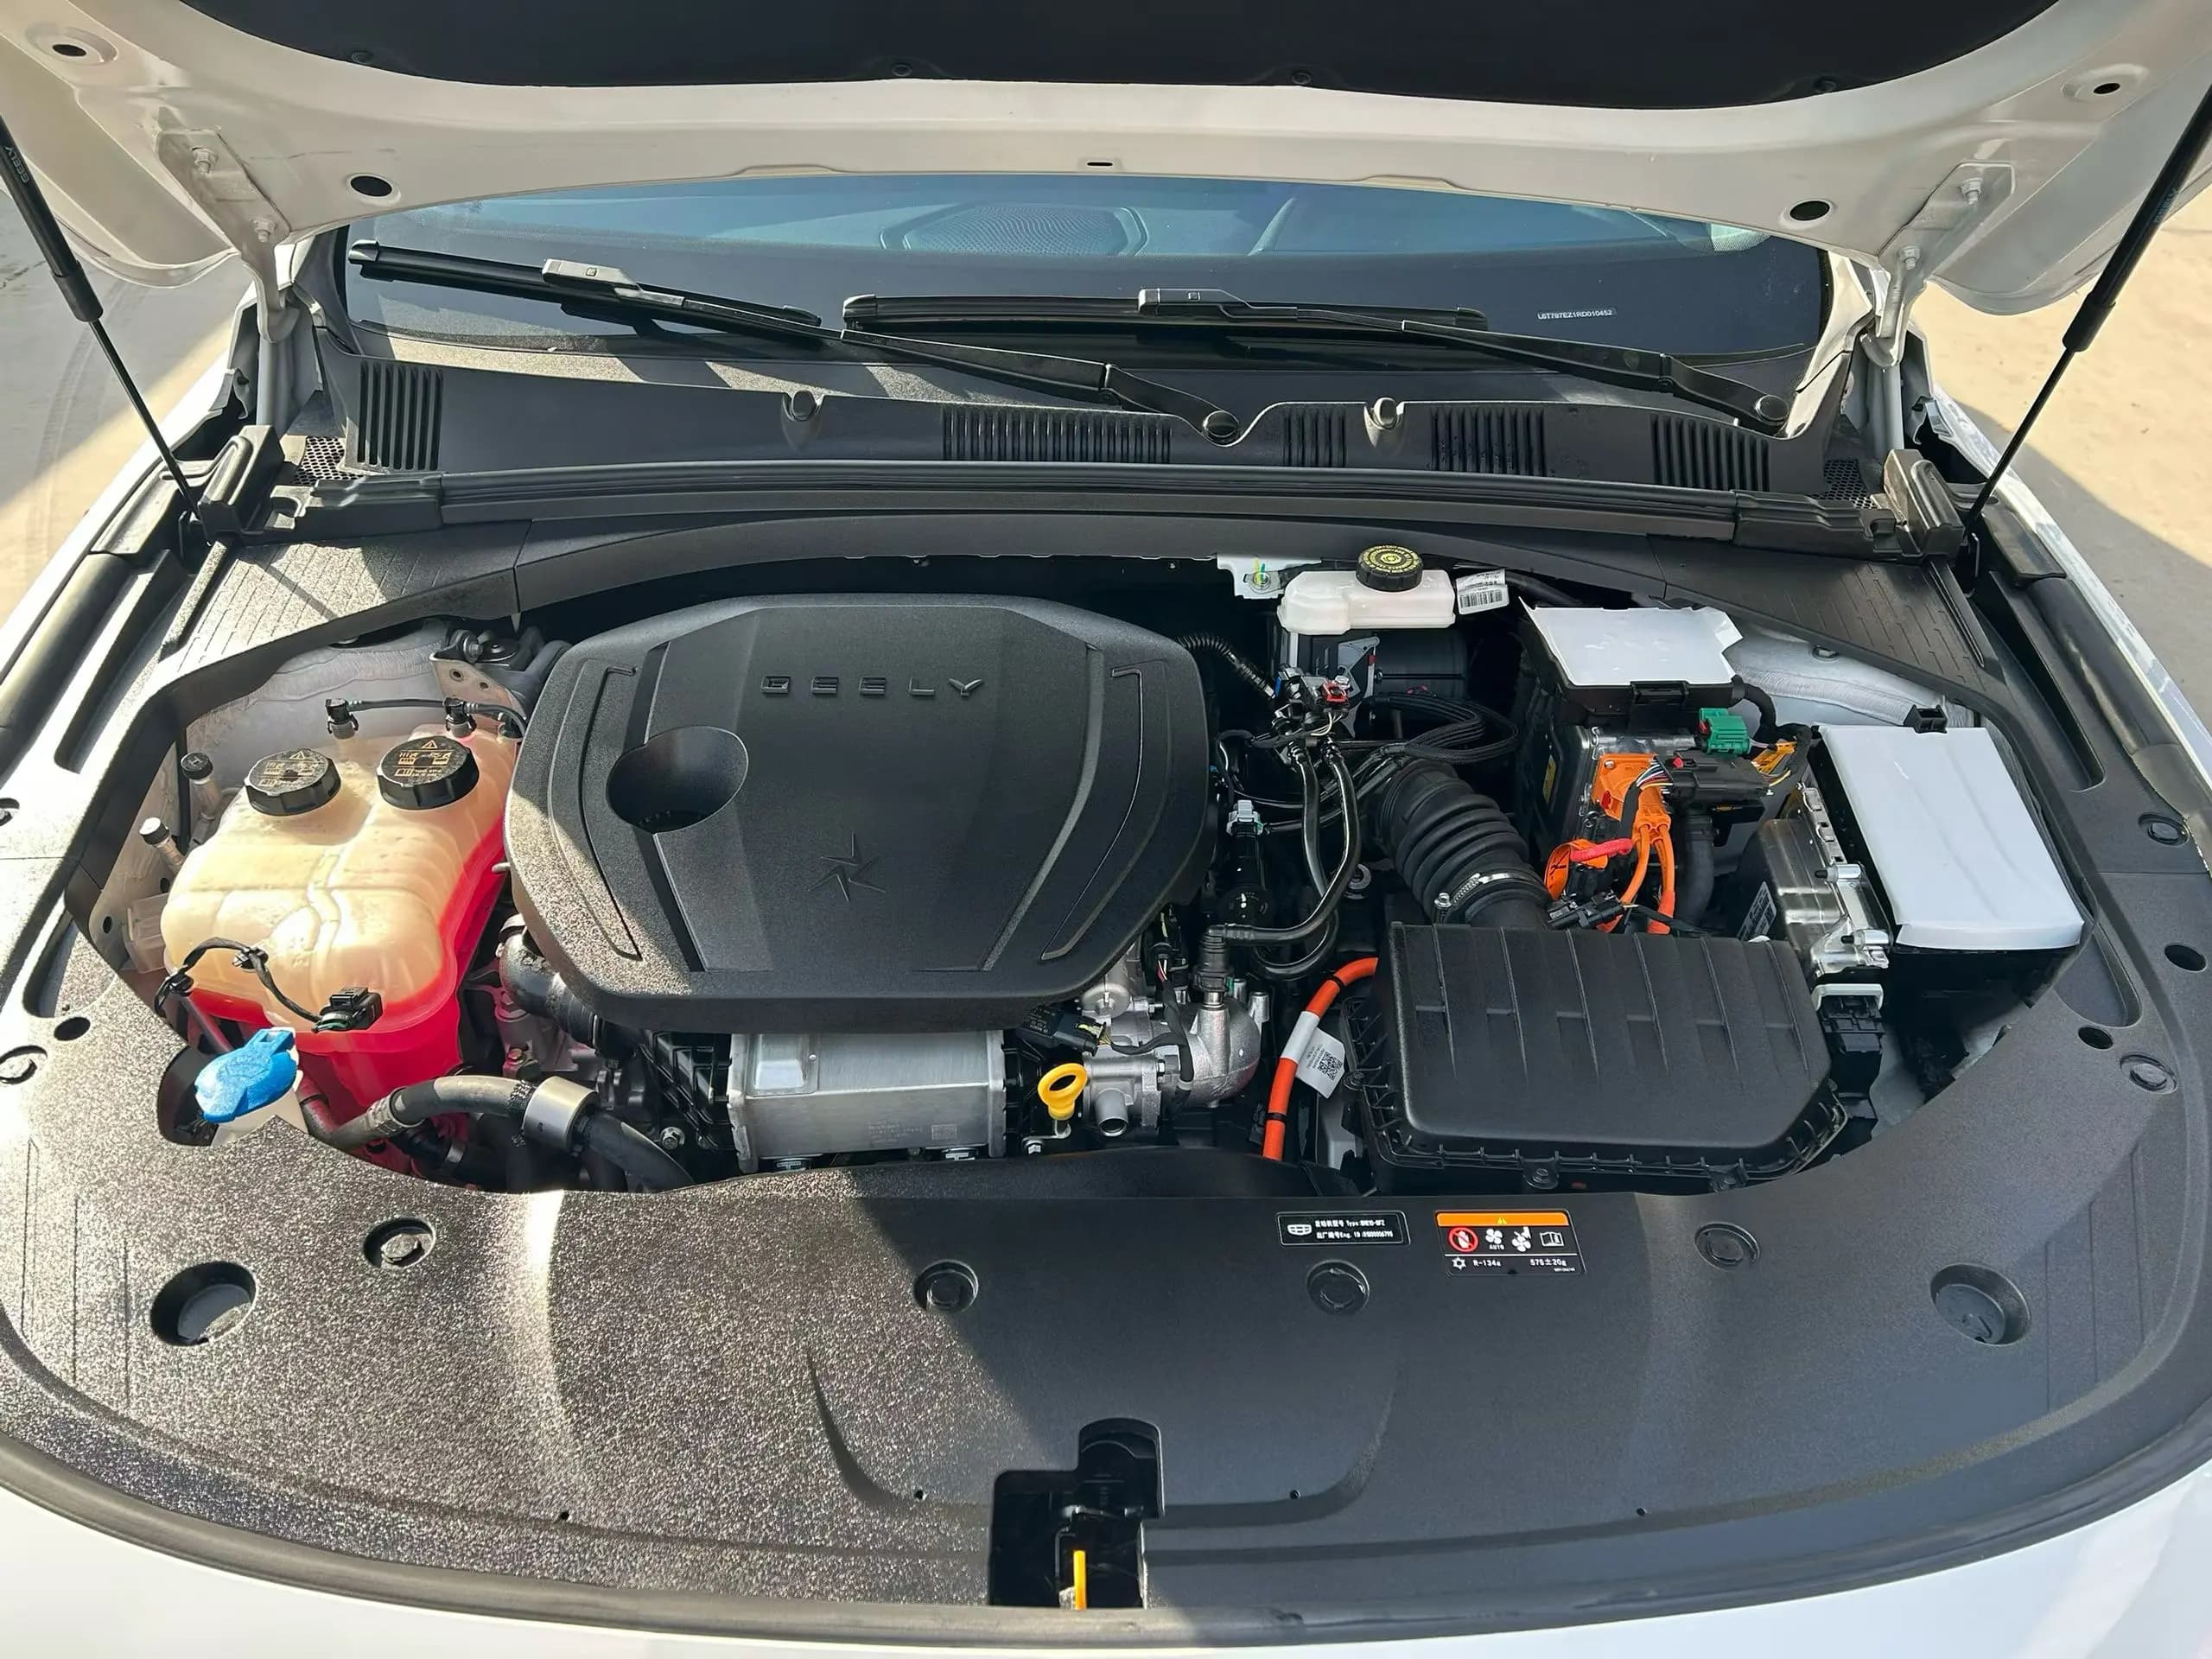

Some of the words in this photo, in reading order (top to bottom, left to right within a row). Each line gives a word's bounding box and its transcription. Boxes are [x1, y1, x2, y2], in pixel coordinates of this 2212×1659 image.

[4, 146, 30, 183] GEELY
[760, 674, 985, 698] GEELY
[1472, 1259, 1502, 1268] R-134a
